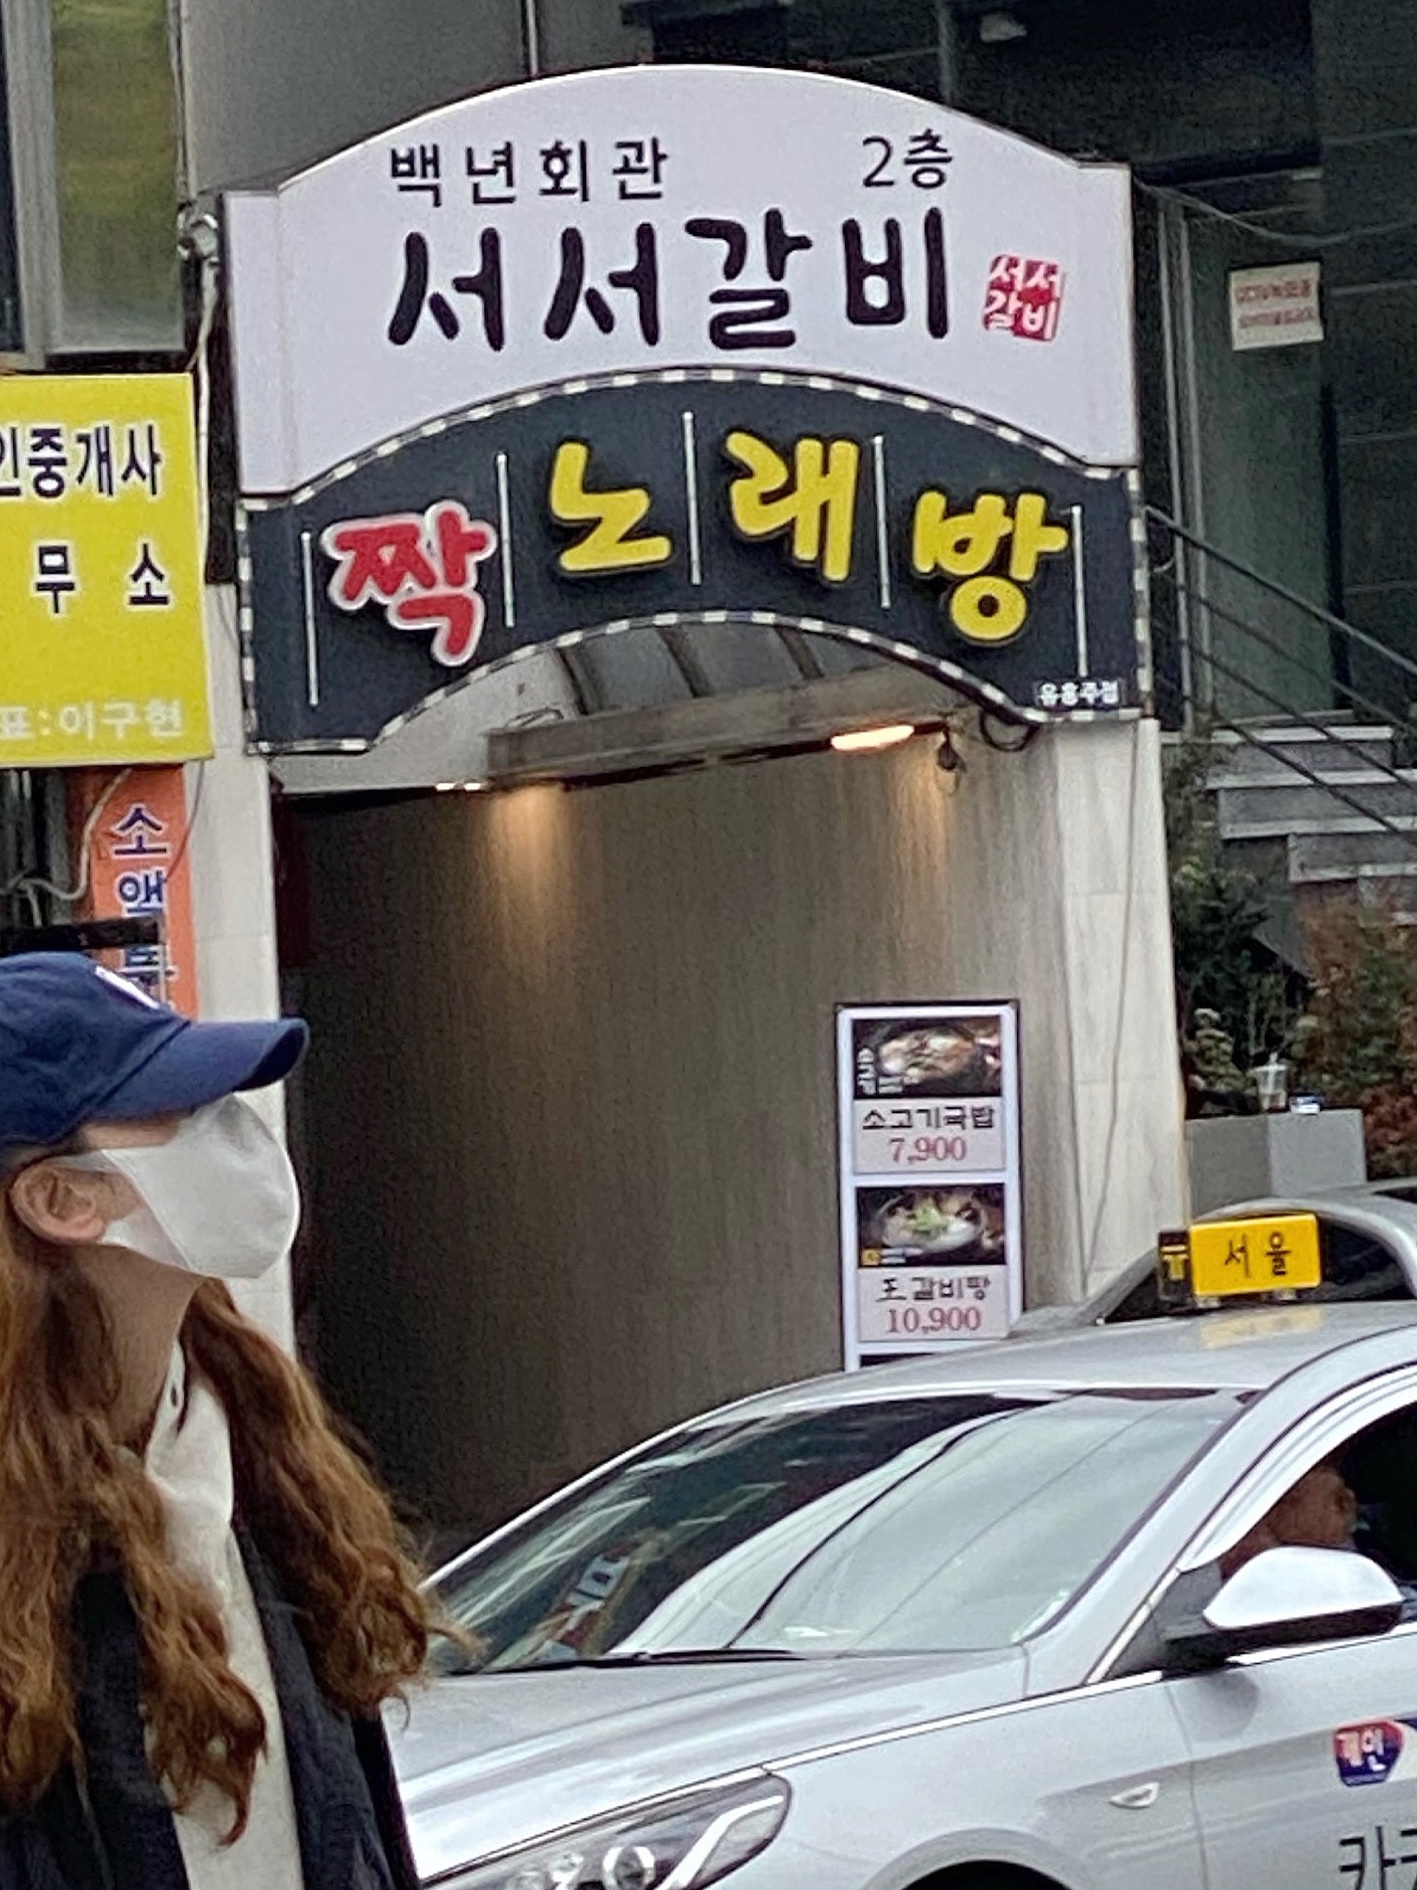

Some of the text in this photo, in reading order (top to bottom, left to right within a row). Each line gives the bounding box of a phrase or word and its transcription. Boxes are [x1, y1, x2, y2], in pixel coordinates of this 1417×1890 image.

[388, 127, 955, 209] 백년회관 2층
[387, 207, 951, 353] 서서갈비
[322, 428, 1070, 668] 짝 노래방
[862, 1104, 996, 1131] 소고기국밥
[888, 1134, 967, 1165] 7,900
[1224, 1231, 1293, 1278] 서울
[887, 1305, 982, 1335] 10,900
[1337, 1729, 1387, 1772] 개인
